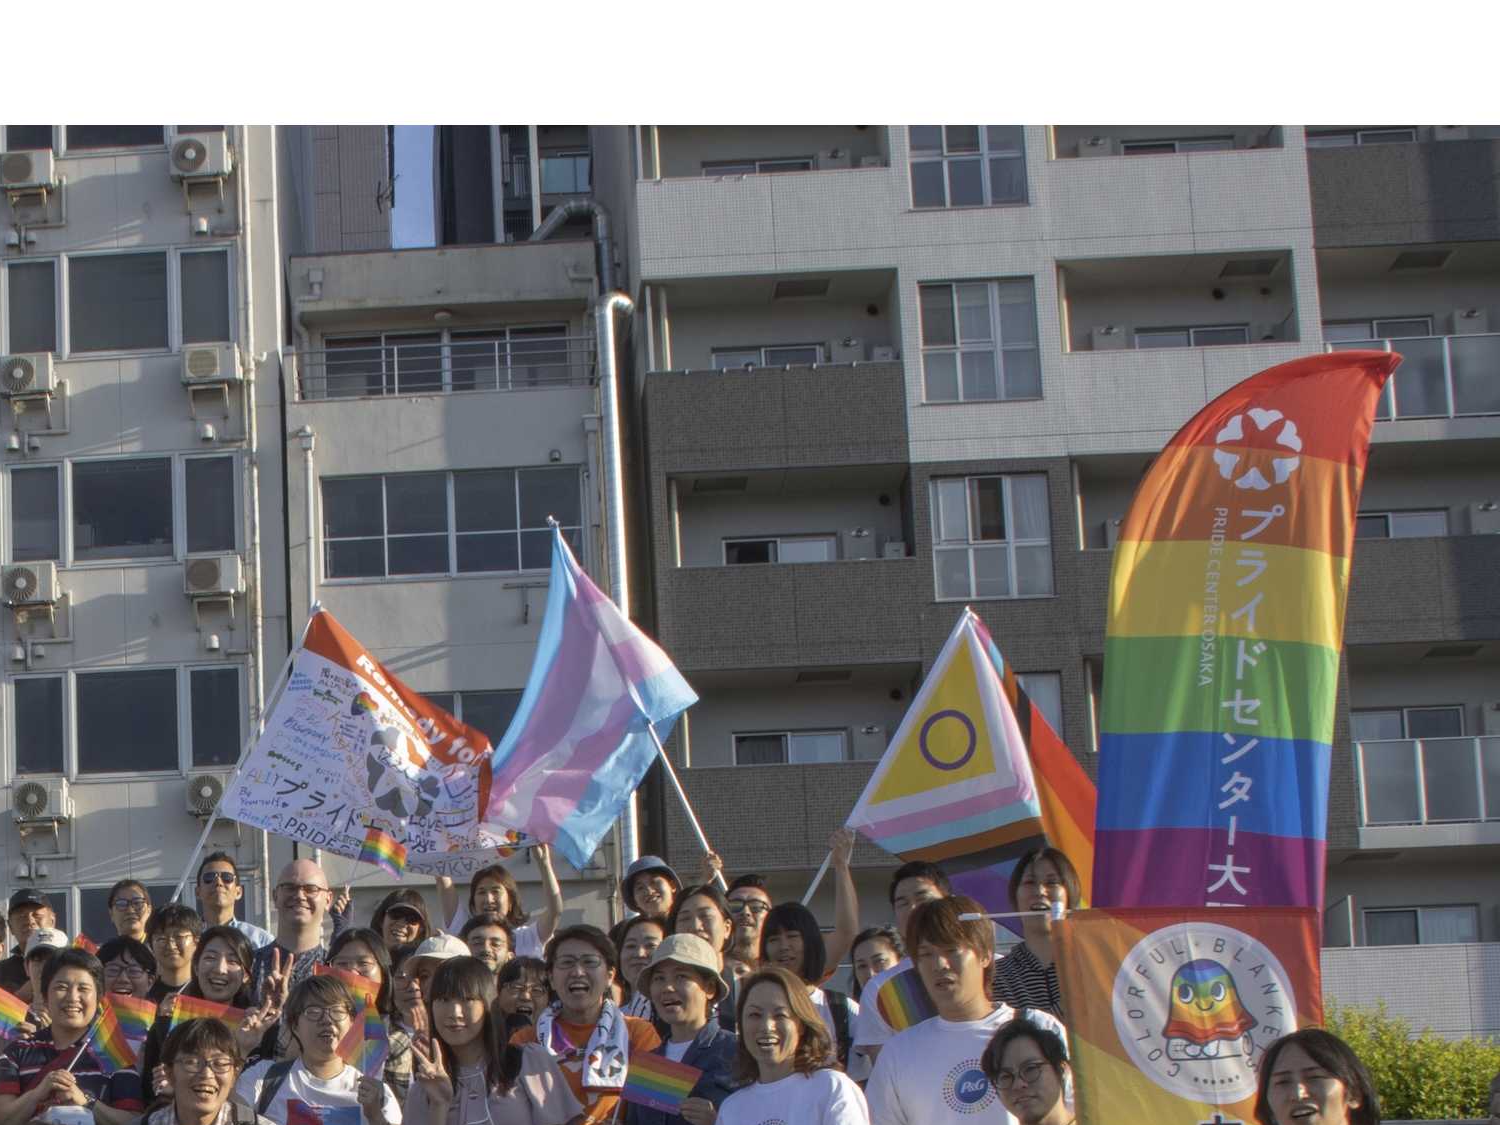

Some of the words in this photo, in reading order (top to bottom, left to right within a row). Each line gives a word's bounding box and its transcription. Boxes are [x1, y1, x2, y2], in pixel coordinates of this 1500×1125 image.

[1210, 507, 1228, 555] PRIDE
[1203, 559, 1221, 625] CENTER
[1198, 629, 1217, 687] OSAKA
[1206, 504, 1285, 908] プライドセンター大
[409, 814, 443, 832] LOVE
[1127, 939, 1185, 1078] COLORFUL
[961, 1079, 985, 1093] P&G
